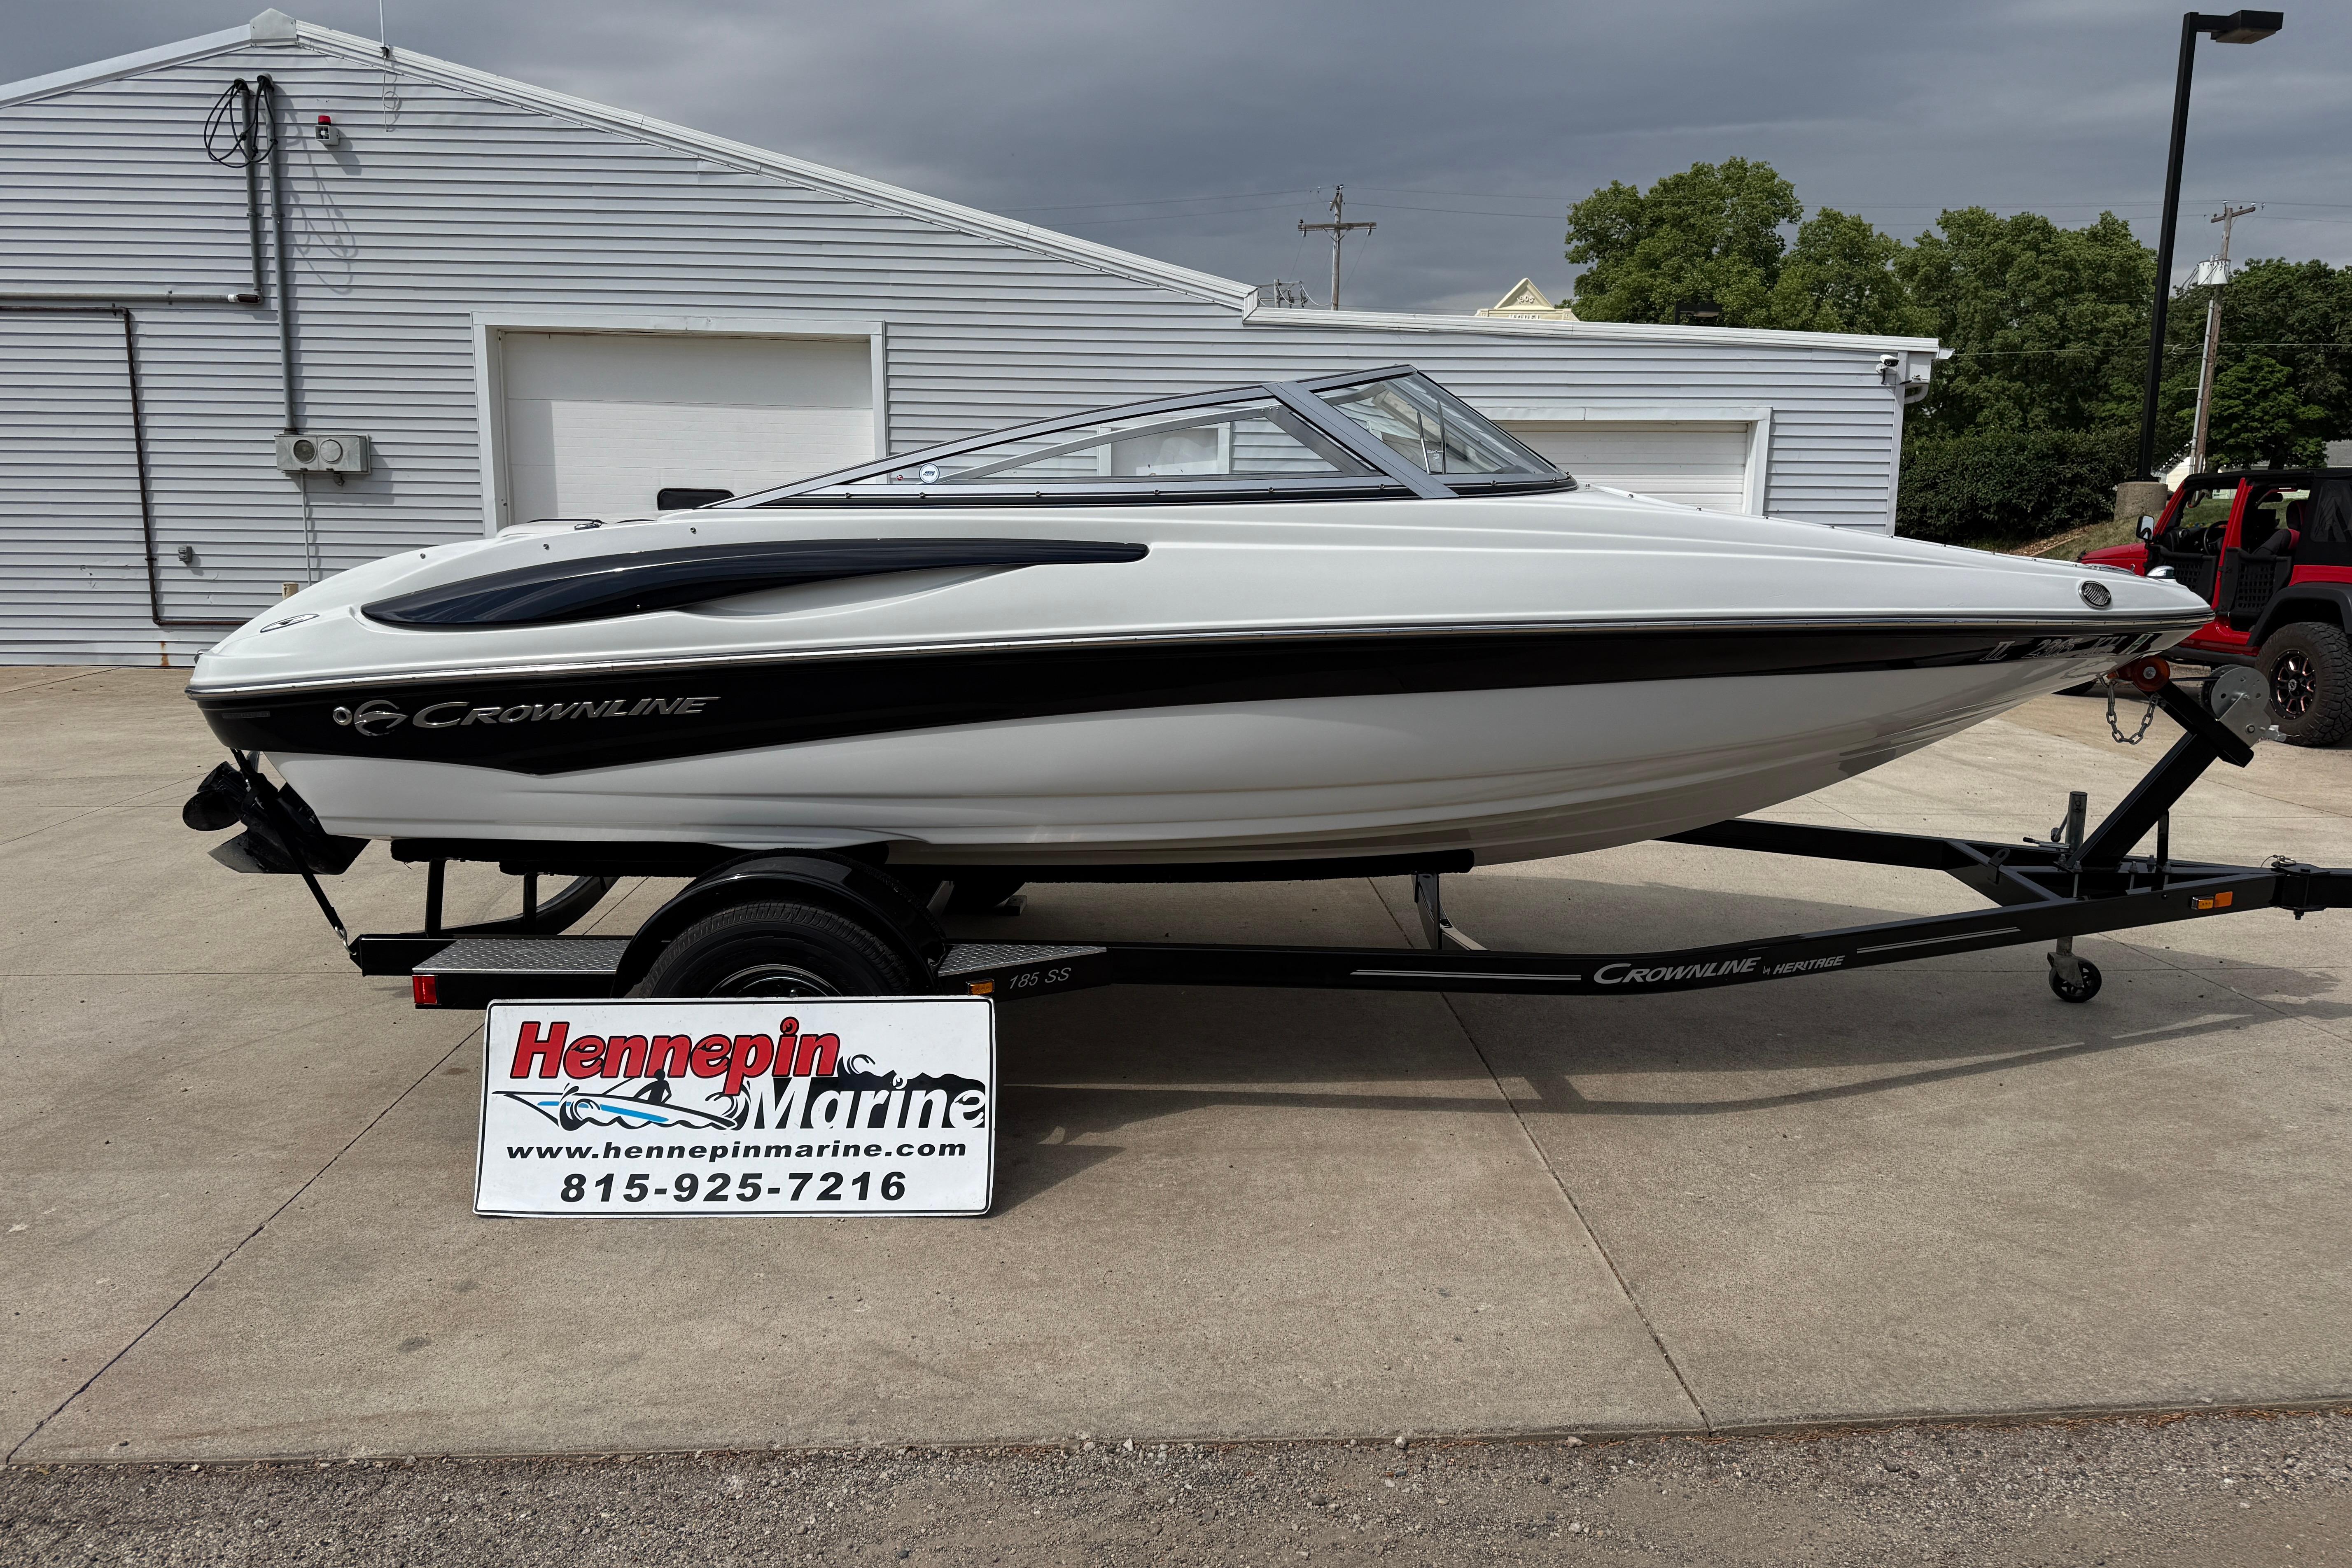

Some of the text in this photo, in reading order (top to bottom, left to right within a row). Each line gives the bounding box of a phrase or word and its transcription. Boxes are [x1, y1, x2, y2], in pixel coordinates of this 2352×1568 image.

[1979, 641, 2015, 661] IL
[413, 697, 721, 728] CROWNLINE
[1009, 967, 1071, 989] 185 SS
[1593, 957, 1762, 984] CROWNLINE
[1773, 955, 1845, 975] HERITAGE
[509, 1016, 841, 1095] Hennepin
[754, 1076, 985, 1129] Marine
[506, 1140, 967, 1163] www.hennepinmarine.com
[560, 1171, 906, 1203] 815-925-7216
